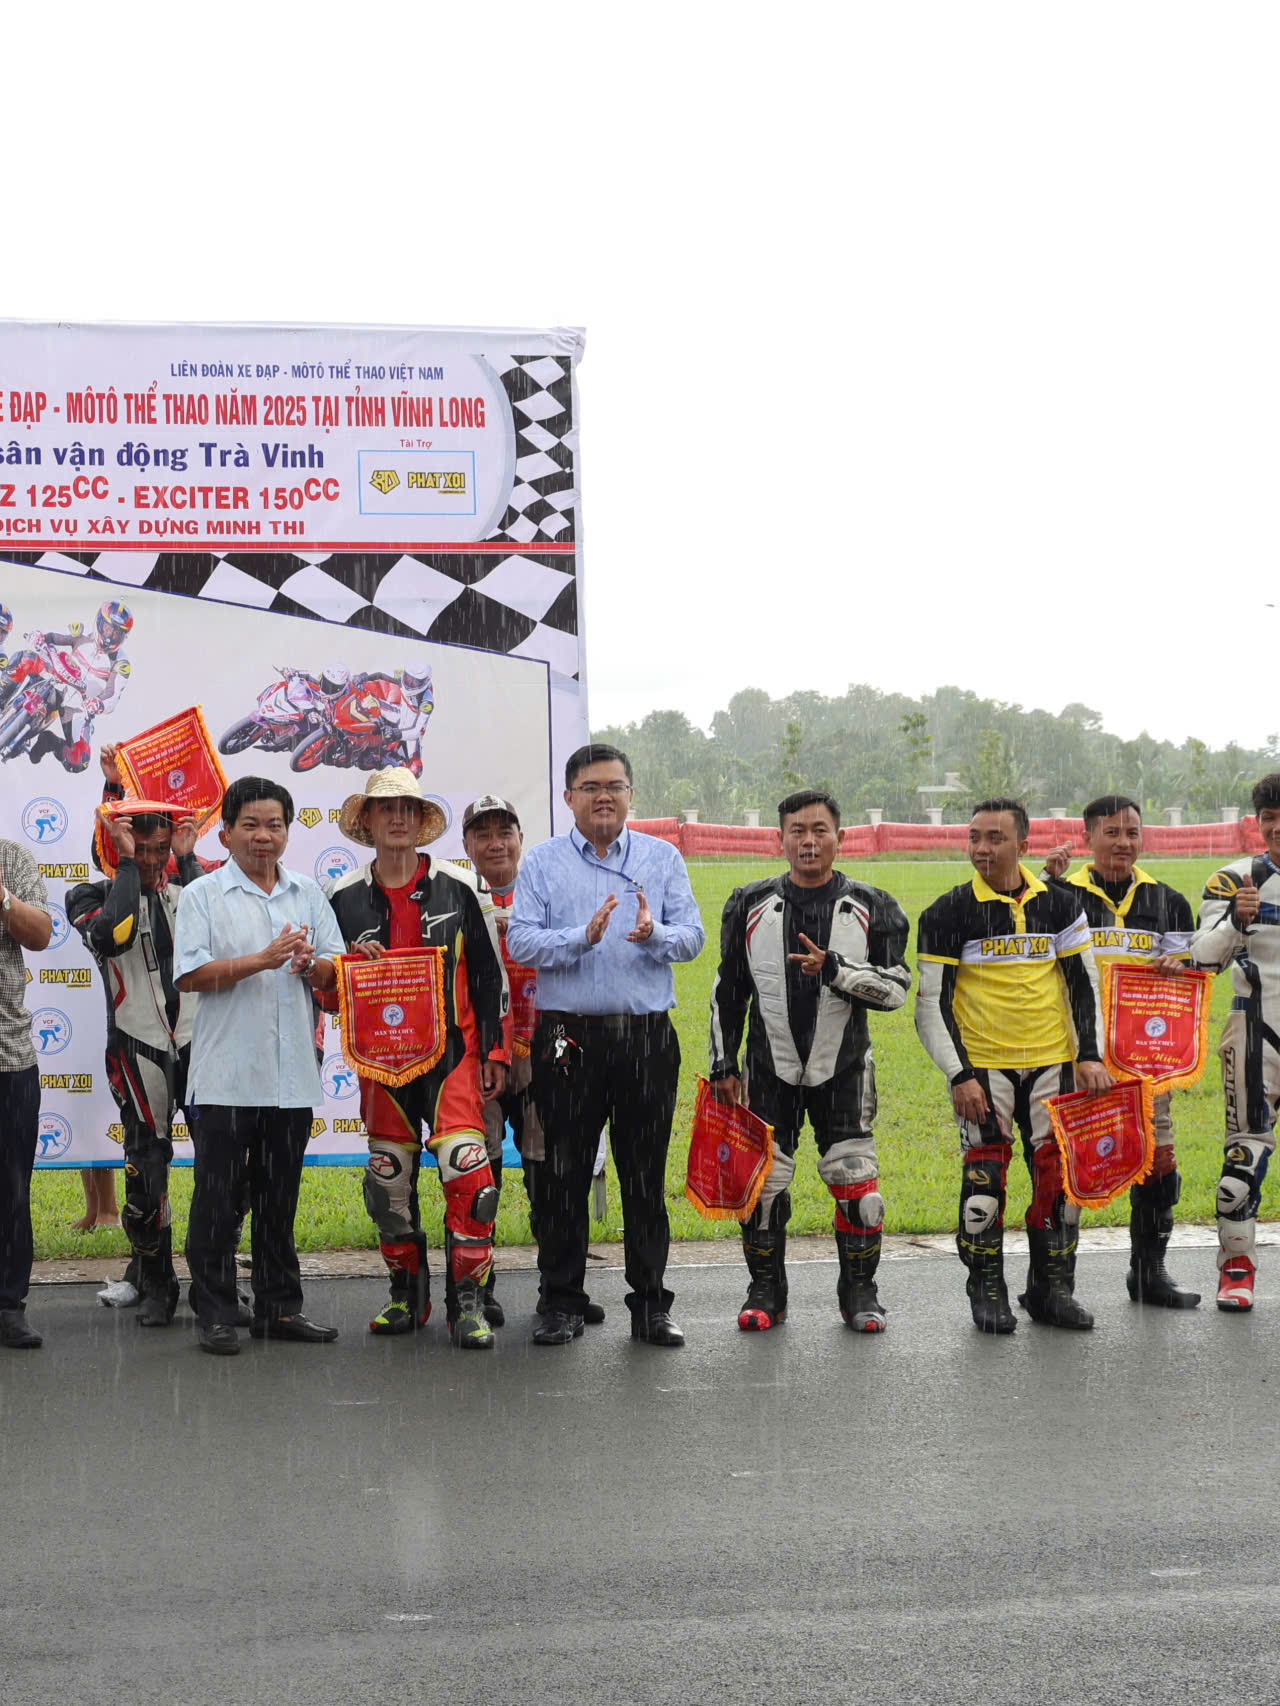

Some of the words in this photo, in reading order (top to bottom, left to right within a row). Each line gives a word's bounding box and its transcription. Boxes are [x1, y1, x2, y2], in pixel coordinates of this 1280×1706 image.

[171, 359, 197, 377] LIÊN
[201, 360, 233, 378] ĐOÀN
[237, 364, 252, 378] XE
[256, 365, 280, 381] ĐẠP
[291, 361, 324, 379] MÔTÔ
[328, 358, 351, 379] THỂ
[355, 366, 386, 380] THAO
[389, 362, 415, 383] VIỆT
[419, 366, 443, 380] NAM
[9, 391, 48, 429] ĐẠP
[66, 386, 119, 424] MÔTÔ
[123, 380, 157, 425] THỂ
[162, 393, 210, 425] THAO
[215, 388, 258, 425] NĂM
[263, 396, 307, 427] 2025
[312, 396, 340, 433] TẠI
[345, 385, 386, 427] TỈNH
[391, 391, 434, 428] VĨNH
[439, 397, 486, 428] LONG
[400, 439, 414, 448] Tài
[416, 439, 433, 449] Trợ
[53, 442, 106, 471] vận
[116, 442, 189, 472] động
[199, 443, 251, 469] Trà
[261, 443, 325, 469] Vinh
[407, 472, 442, 488] PHAT
[134, 485, 249, 510] EXCITER
[50, 519, 78, 536] VỤ
[87, 515, 130, 535] XÂY
[138, 517, 199, 538] DỰNG
[206, 519, 261, 535] MINH
[269, 520, 305, 535] THI
[38, 864, 68, 878] PHAT
[981, 938, 1026, 955] PHAT
[40, 969, 70, 983] PHAT
[40, 1074, 71, 1088] PHAT
[1223, 1047, 1241, 1133] TAICHI
